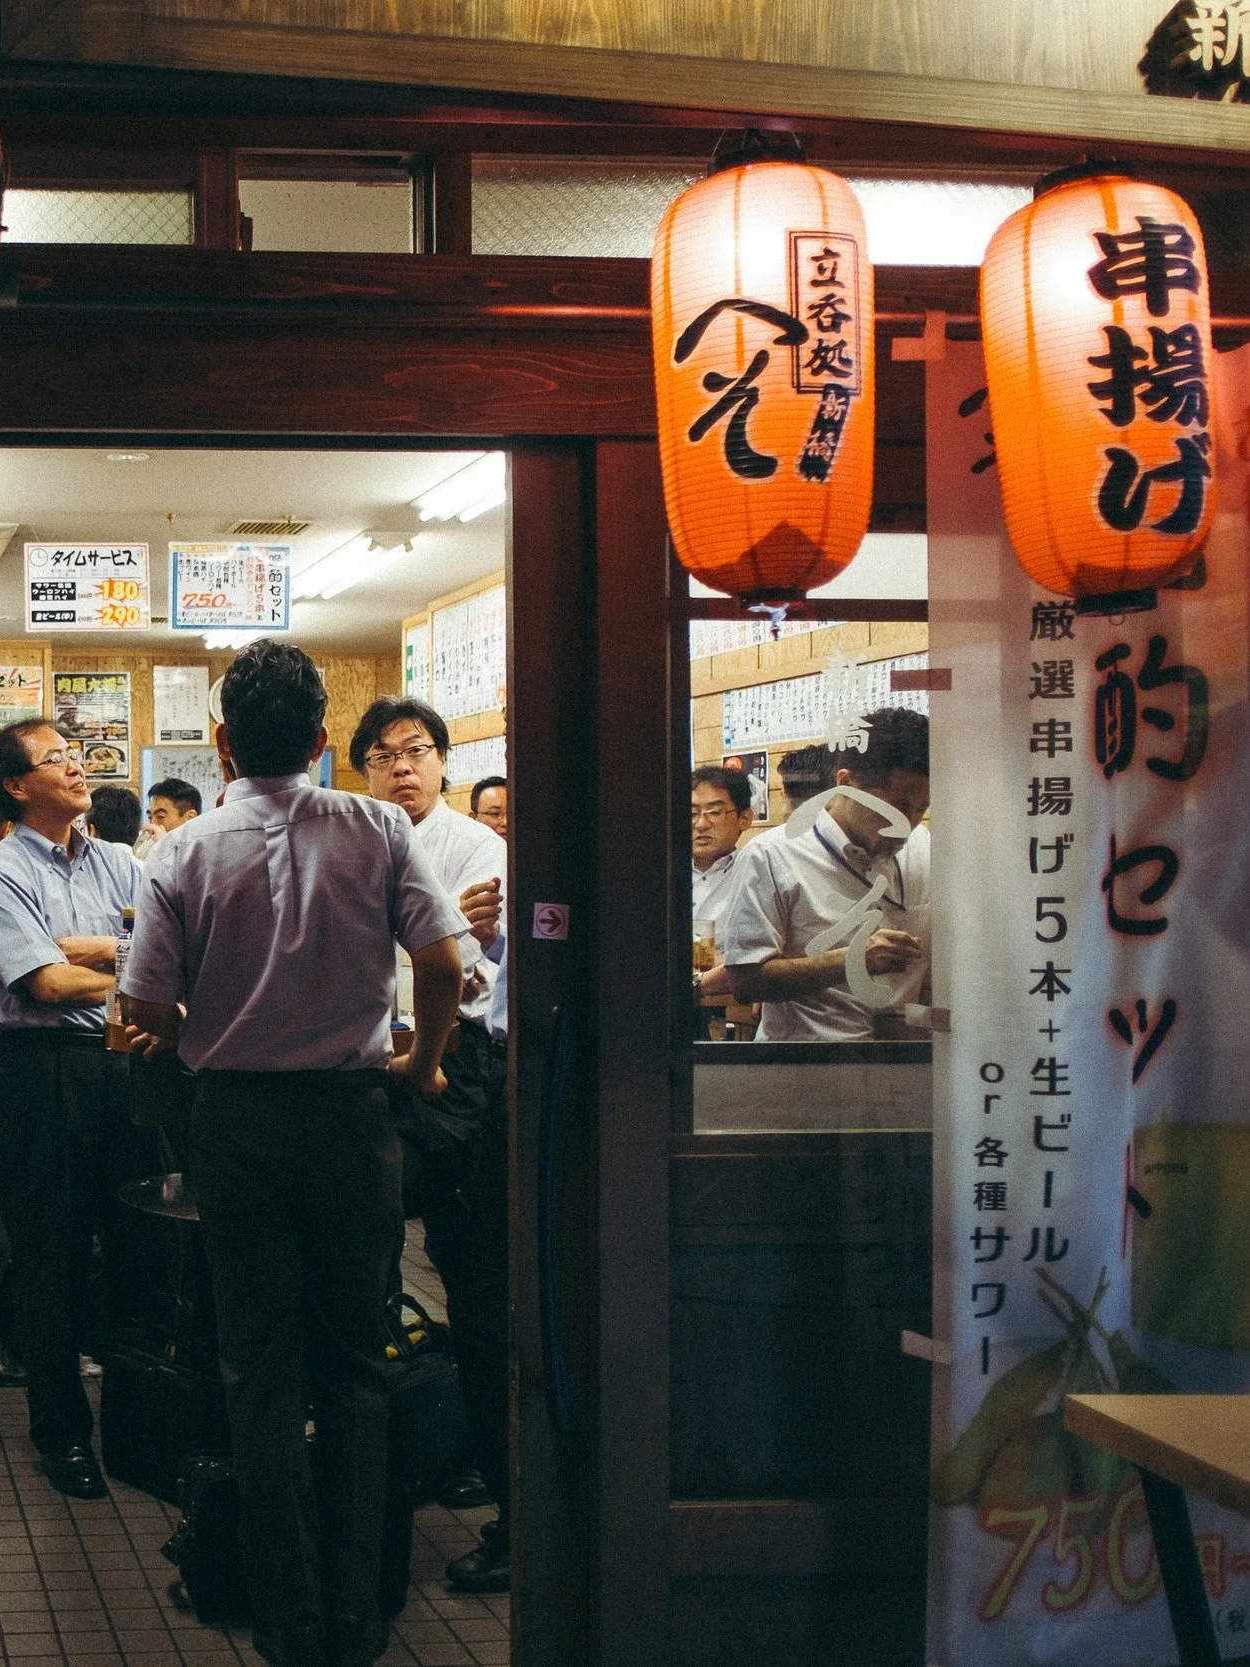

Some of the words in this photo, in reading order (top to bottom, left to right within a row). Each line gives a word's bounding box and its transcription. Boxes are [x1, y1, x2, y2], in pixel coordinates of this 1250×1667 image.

[804, 247, 853, 378] 立呑処
[673, 298, 810, 479] へそ
[1086, 216, 1212, 534] 串揚げ
[51, 550, 138, 566] タイムサービス
[102, 580, 139, 600] 180
[102, 606, 139, 625] 290
